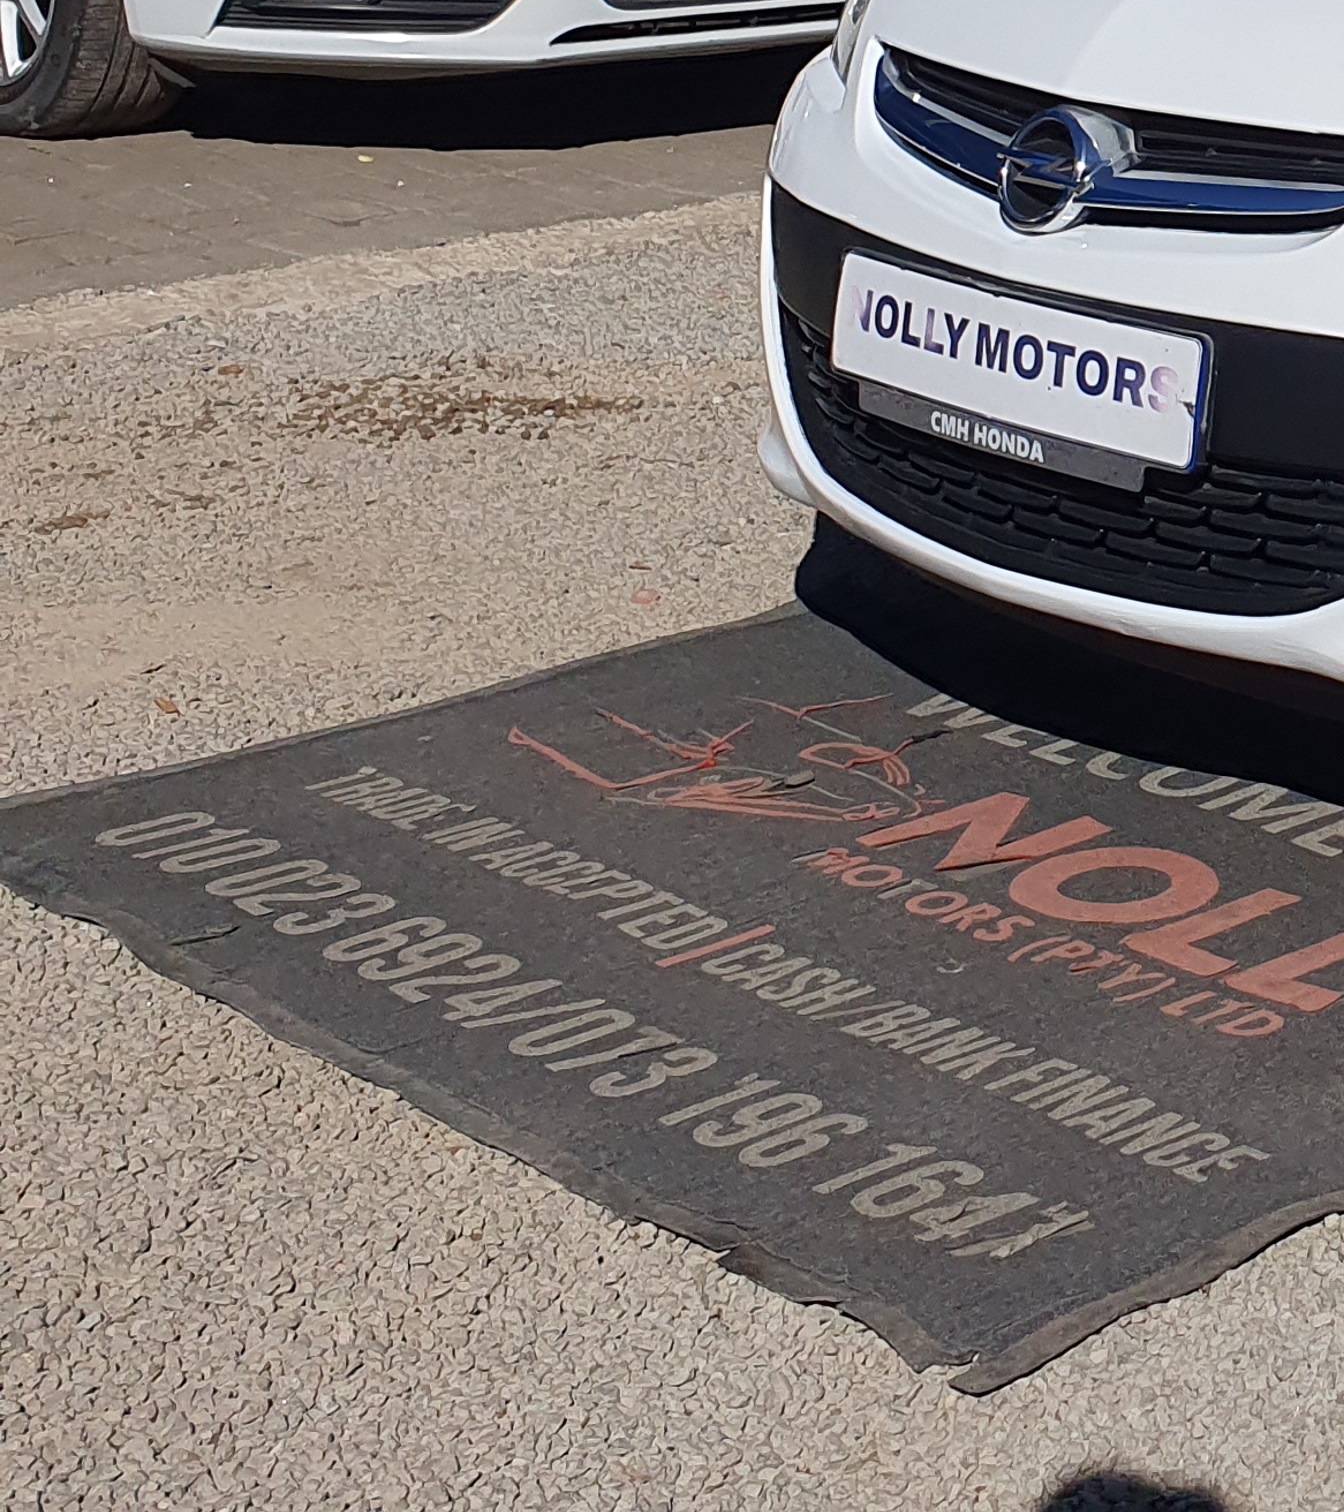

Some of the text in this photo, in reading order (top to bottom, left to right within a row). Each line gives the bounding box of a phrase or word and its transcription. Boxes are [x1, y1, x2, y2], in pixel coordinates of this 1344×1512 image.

[930, 410, 1045, 464] CMH HONDA
[974, 322, 1180, 414] MOTORS
[95, 811, 282, 874] 010
[205, 858, 397, 936] 023
[658, 1073, 869, 1168] 196
[422, 817, 526, 852] IN
[984, 1057, 1272, 1183] FINANCE
[792, 848, 1036, 941] MOTORS
[1008, 935, 1176, 1003] (PTY)
